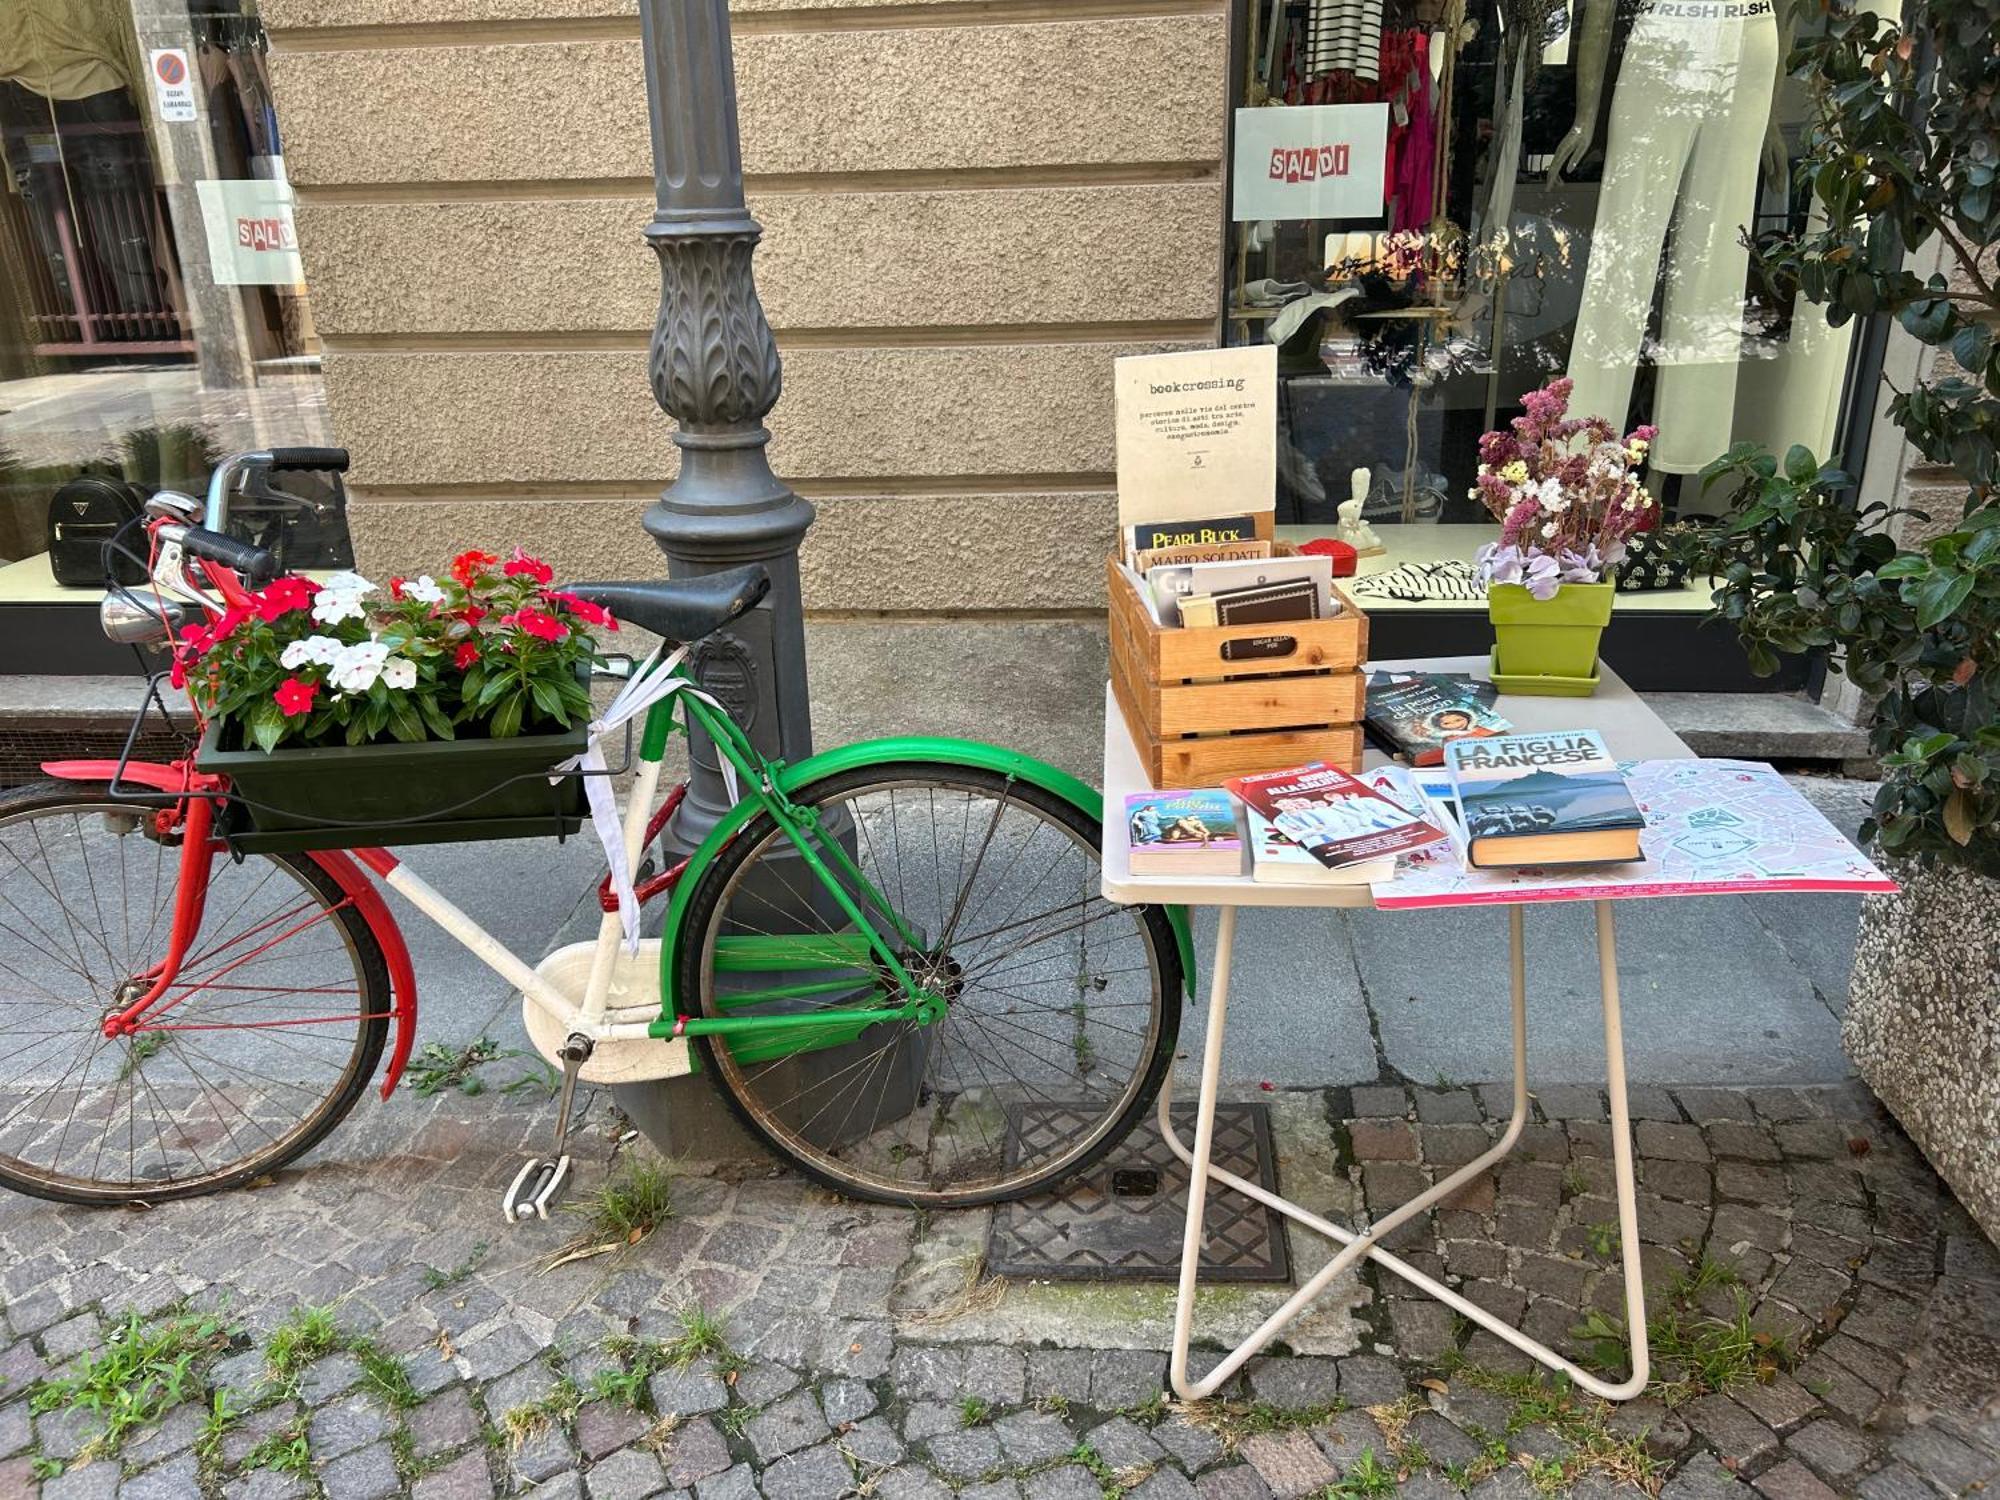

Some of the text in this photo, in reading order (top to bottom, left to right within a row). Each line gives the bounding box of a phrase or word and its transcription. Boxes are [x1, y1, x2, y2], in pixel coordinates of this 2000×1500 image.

[1658, 4, 1719, 18] RLSH
[1724, 1, 1772, 18] RLSH
[1270, 147, 1347, 180] SALDI
[1149, 378, 1246, 394] bookcrossing
[1152, 528, 1240, 549] PEARL BUCK
[1151, 550, 1261, 566] MARIO SOLDATI
[1453, 737, 1598, 760] LA FIGLIA
[1457, 748, 1604, 771] FRANCESE
